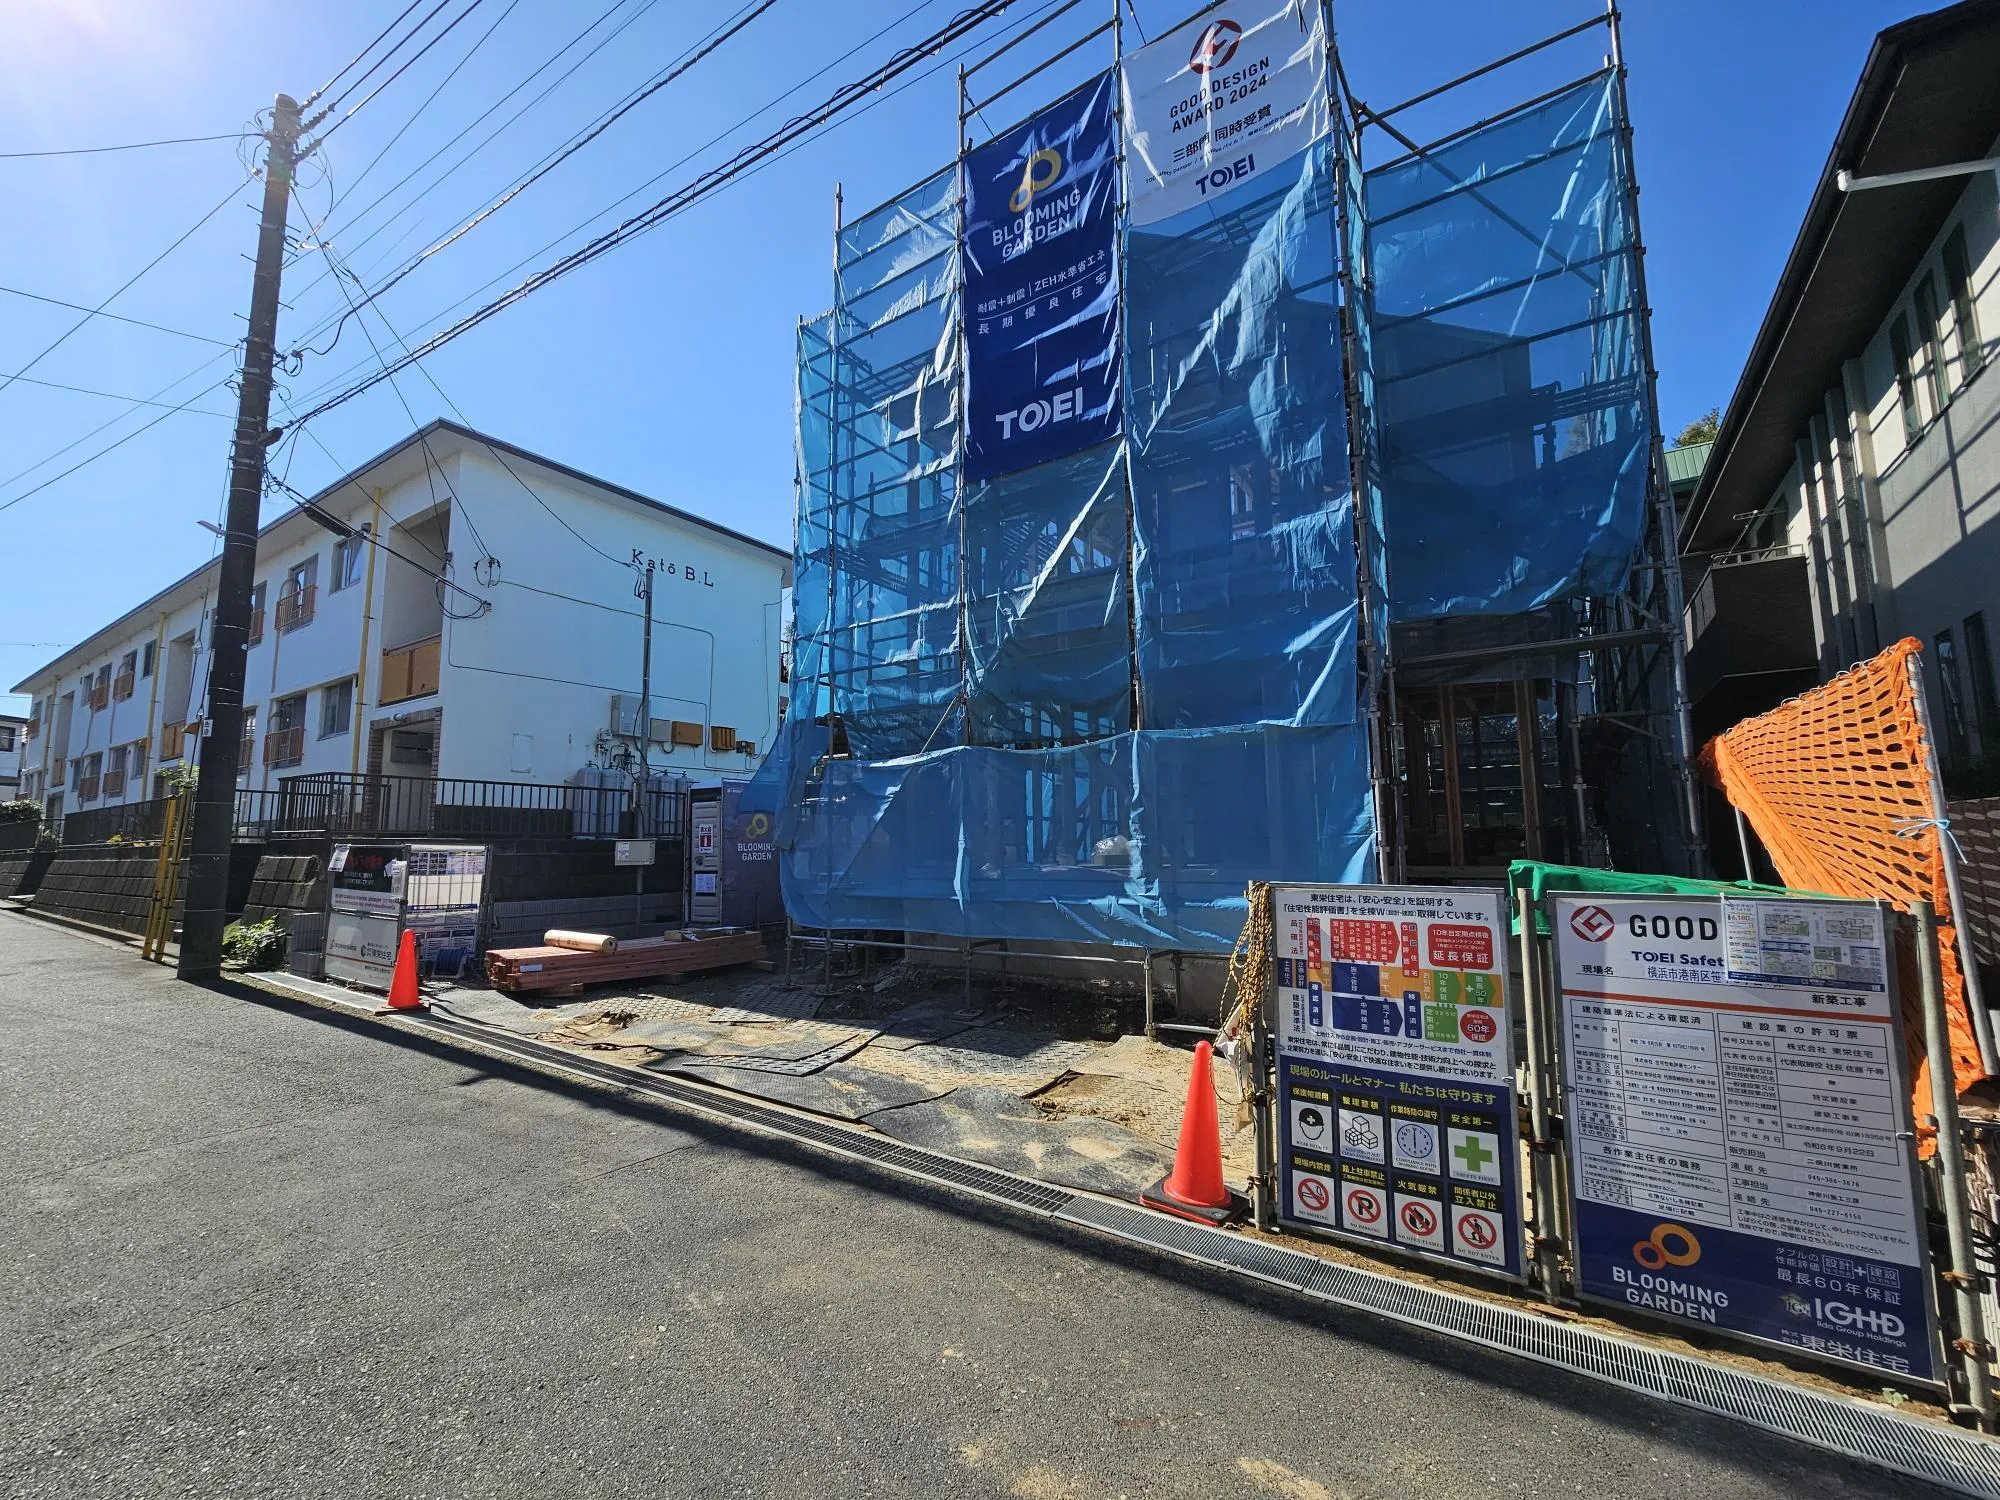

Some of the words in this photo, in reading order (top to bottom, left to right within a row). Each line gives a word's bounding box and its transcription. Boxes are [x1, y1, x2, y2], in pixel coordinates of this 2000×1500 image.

[1170, 88, 1207, 118] GOOD
[1212, 56, 1270, 93] DESIGN
[1172, 97, 1224, 133] AWARD
[1229, 74, 1267, 105] 2024
[1214, 104, 1272, 142] 同時受賞
[1195, 153, 1256, 195] TOEI
[993, 188, 1081, 246] BLOOMING
[1002, 213, 1071, 258] GARDEN
[1034, 249, 1106, 292] ZEH水準省エネ
[978, 270, 1107, 335] 長期優良住宅
[995, 386, 1083, 440] TOEI
[742, 852, 772, 861] GARDEN
[1629, 914, 1718, 941] GOOD
[1433, 950, 1489, 964] 延長保証
[1631, 950, 1675, 964] TOEI
[1680, 953, 1725, 967] Safet
[1582, 964, 1614, 976] 現場名
[1811, 993, 1867, 1008] 新築工事
[1582, 1005, 1701, 1025] 建築基準法による確認済
[1467, 1024, 1490, 1034] 60年
[1742, 1020, 1859, 1040] 建設業の許可票
[1786, 1042, 1826, 1054] 株式会社
[1831, 1047, 1873, 1058] 東栄住宅
[1290, 1064, 1396, 1089] 現場のルールとマナー
[1399, 1081, 1496, 1105] 私たちは守ります
[1451, 1113, 1493, 1126] 安全第一
[1602, 1145, 1702, 1171] 各作業主任者の職務
[1729, 1145, 1766, 1159] 販売担当
[1730, 1161, 1768, 1175] 連絡先
[1397, 1179, 1437, 1196] 火気厳禁
[1454, 1186, 1497, 1201] 関係者以外
[1732, 1177, 1768, 1190] 工事担当
[1455, 1195, 1497, 1210] 立入禁止
[1733, 1192, 1771, 1206] 連絡先
[1776, 1247, 1819, 1262] ダブルの
[1825, 1257, 1851, 1270] 設計
[1612, 1266, 1729, 1308] BLOOMING
[1776, 1267, 1903, 1306] 最長60年保証
[1626, 1288, 1716, 1324] GARDEN
[1814, 1297, 1905, 1337] IGHD
[1835, 1324, 1865, 1338] Group
[1866, 1331, 1907, 1348] Holdings
[1800, 1333, 1910, 1374] 東栄住宅
